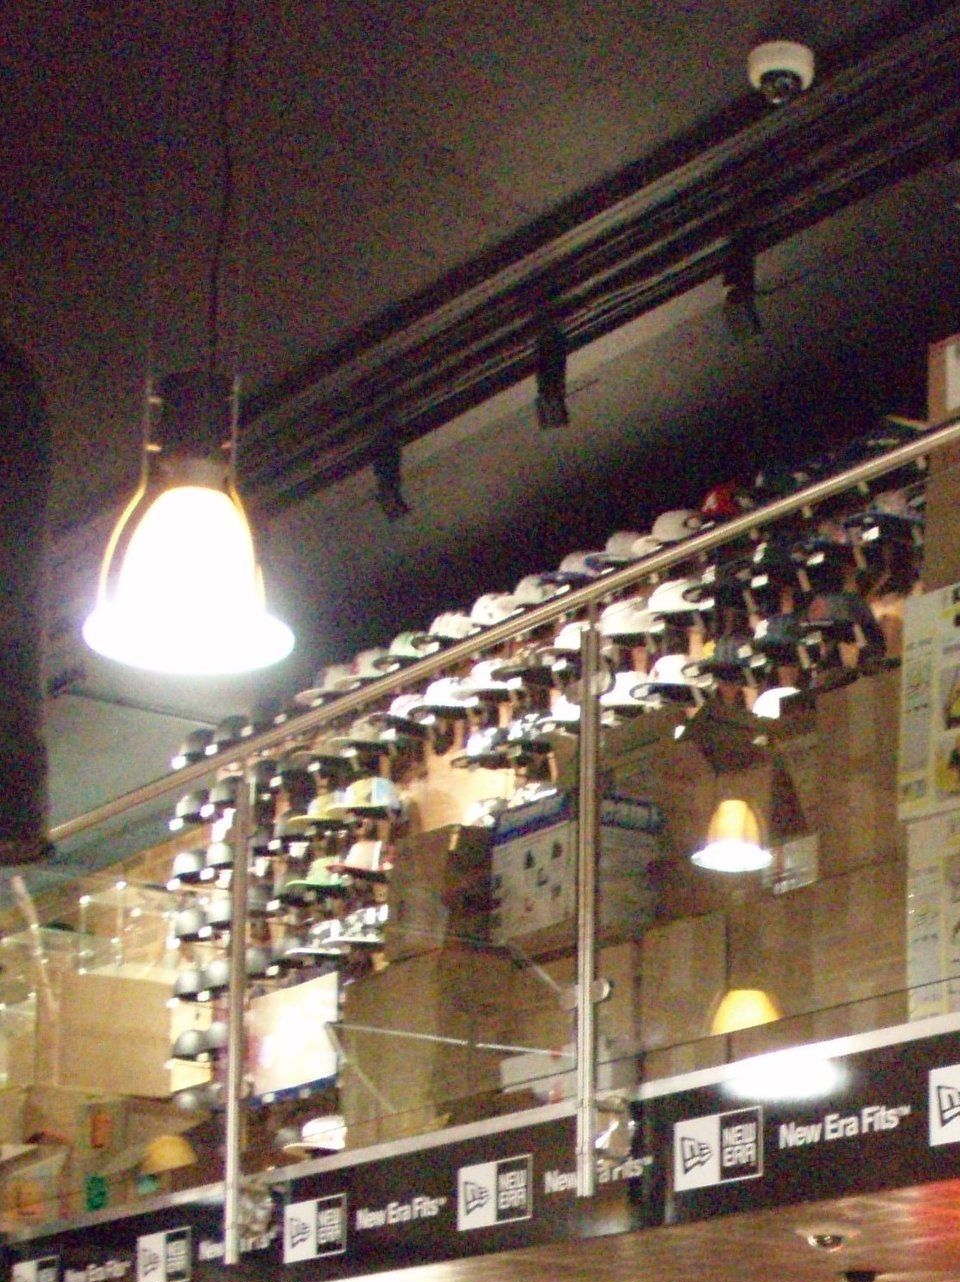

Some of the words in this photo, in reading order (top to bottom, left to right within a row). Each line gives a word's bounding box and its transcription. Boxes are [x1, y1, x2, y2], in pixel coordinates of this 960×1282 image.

[721, 1122, 757, 1147] NEW
[779, 1122, 821, 1149] New
[824, 1113, 859, 1141] Era
[722, 1144, 757, 1168] ERA
[356, 1207, 386, 1231] New
[387, 1201, 411, 1225] Era
